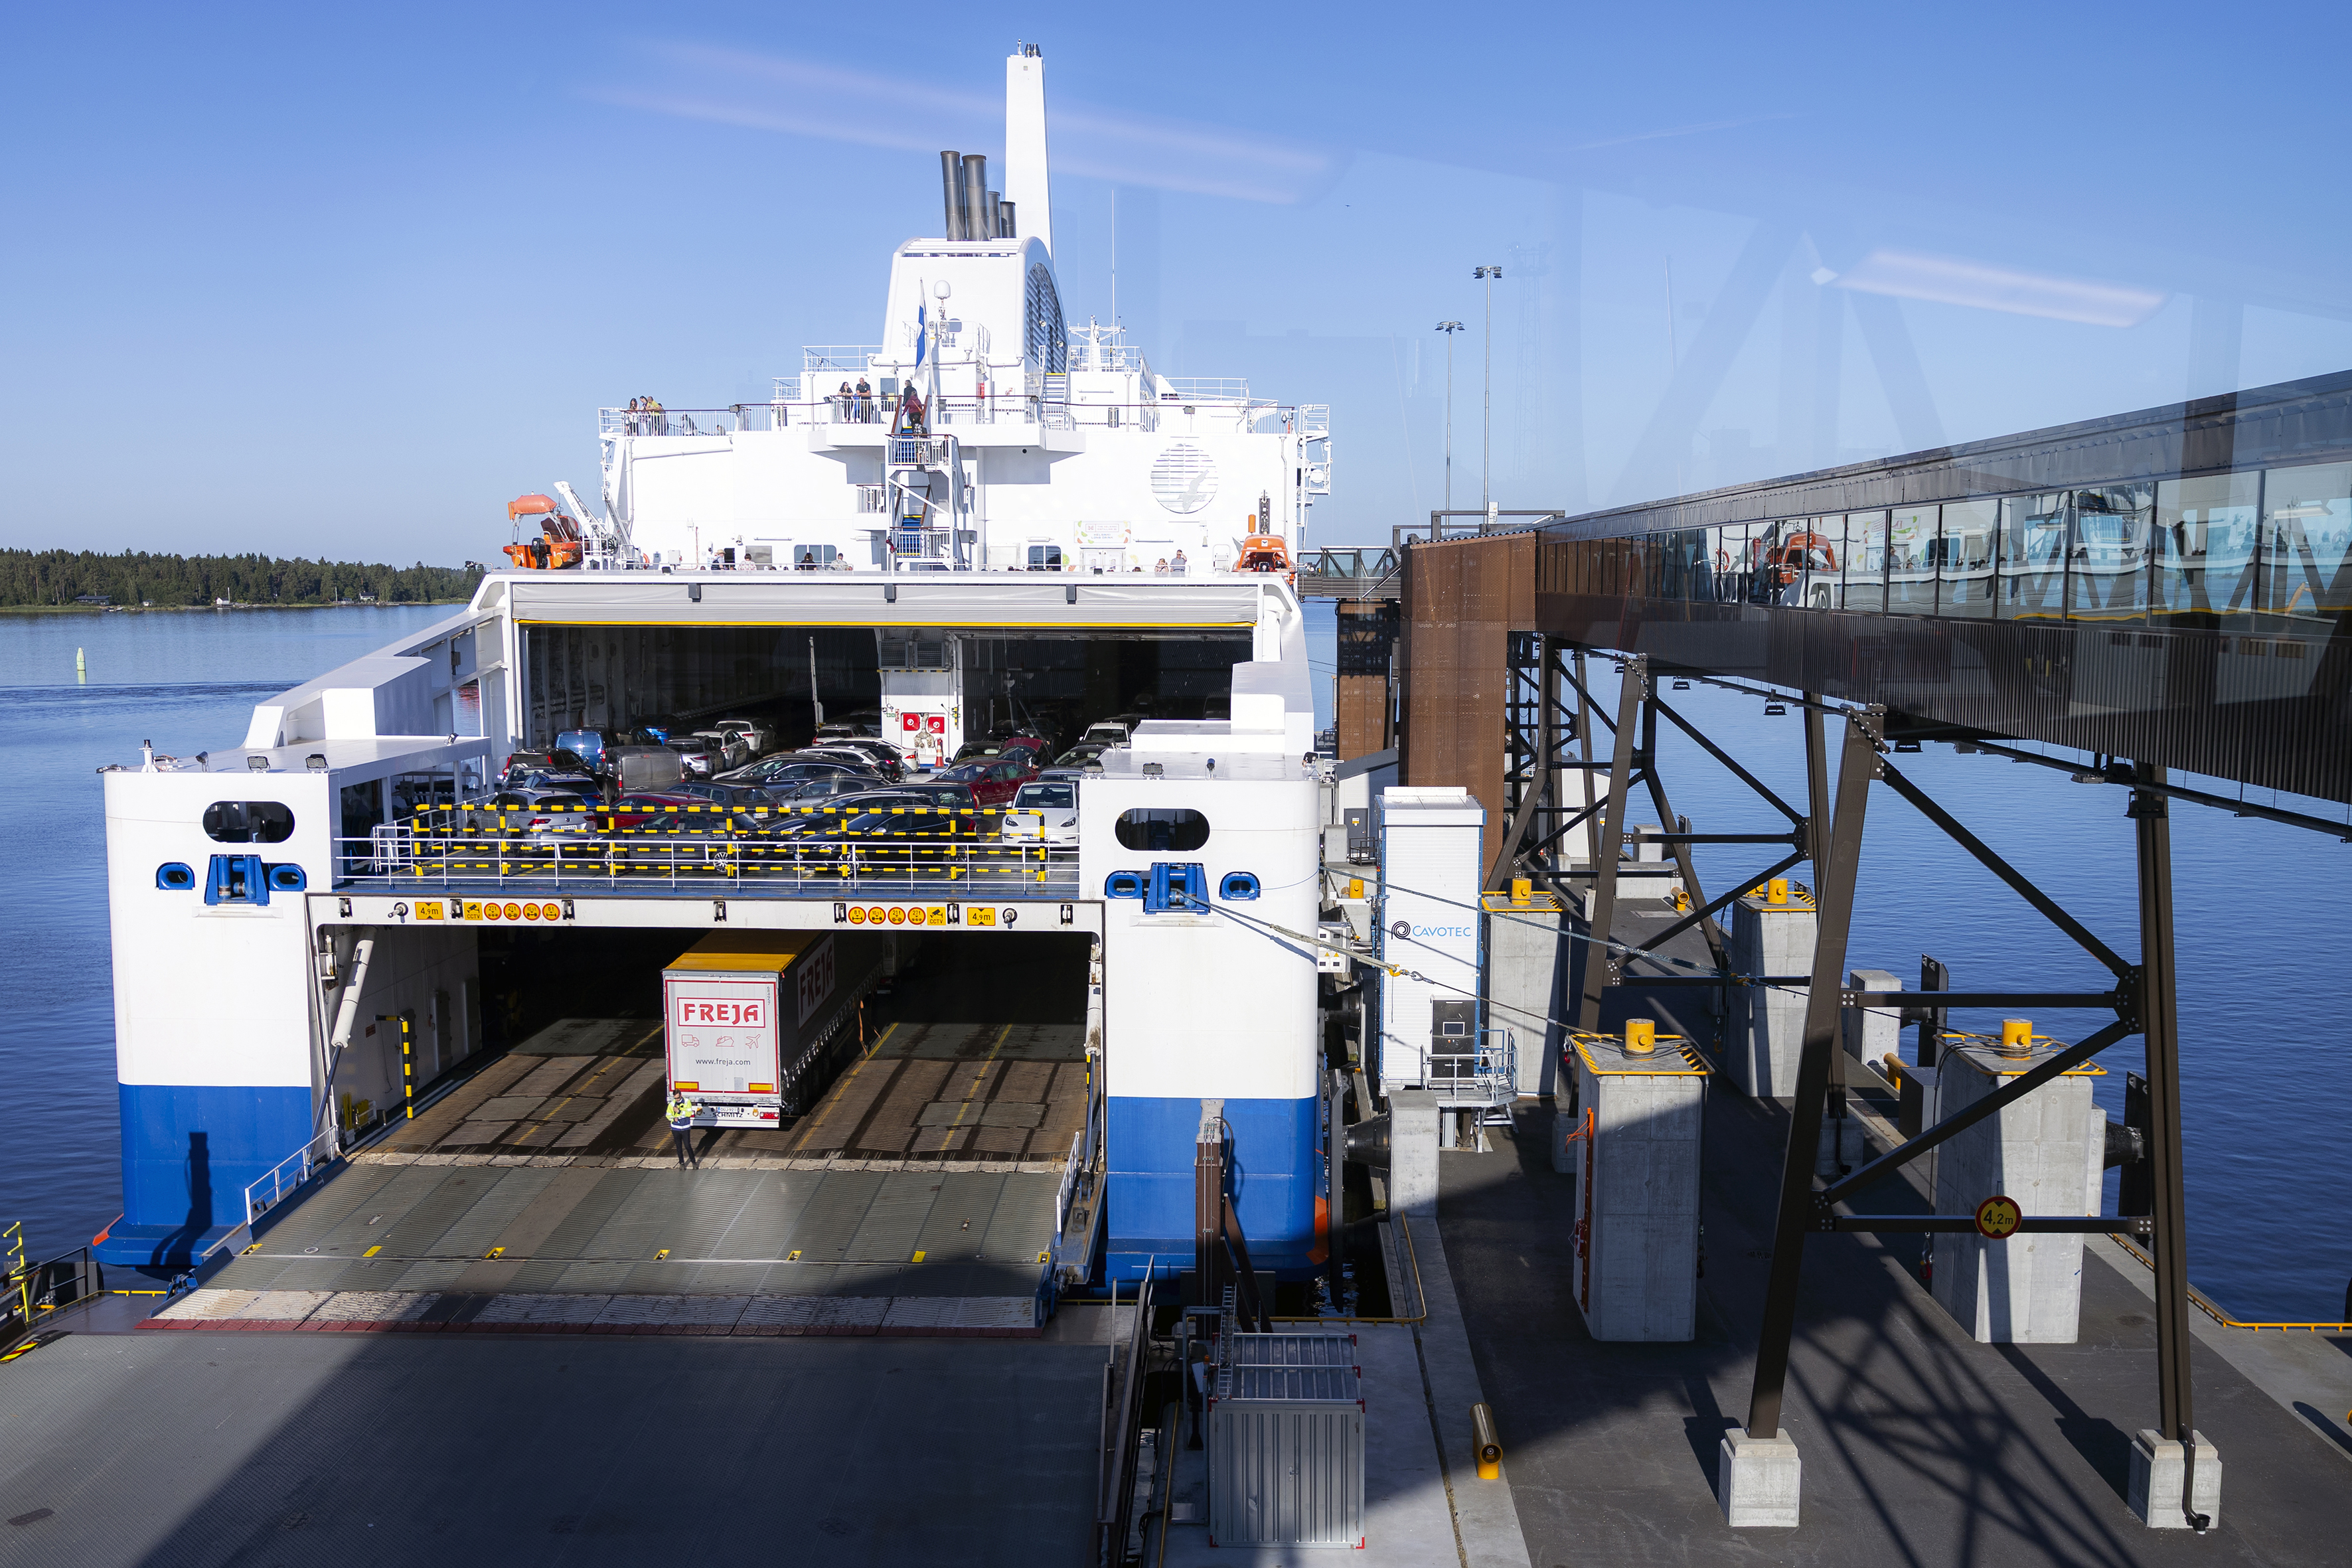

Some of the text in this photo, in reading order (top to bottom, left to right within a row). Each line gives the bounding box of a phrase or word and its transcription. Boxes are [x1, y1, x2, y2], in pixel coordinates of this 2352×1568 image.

[1412, 925, 1471, 937] CAVOTEC
[800, 943, 832, 1019] FREJA
[684, 1003, 759, 1025] FREJA
[695, 1058, 751, 1067] www.freja.com
